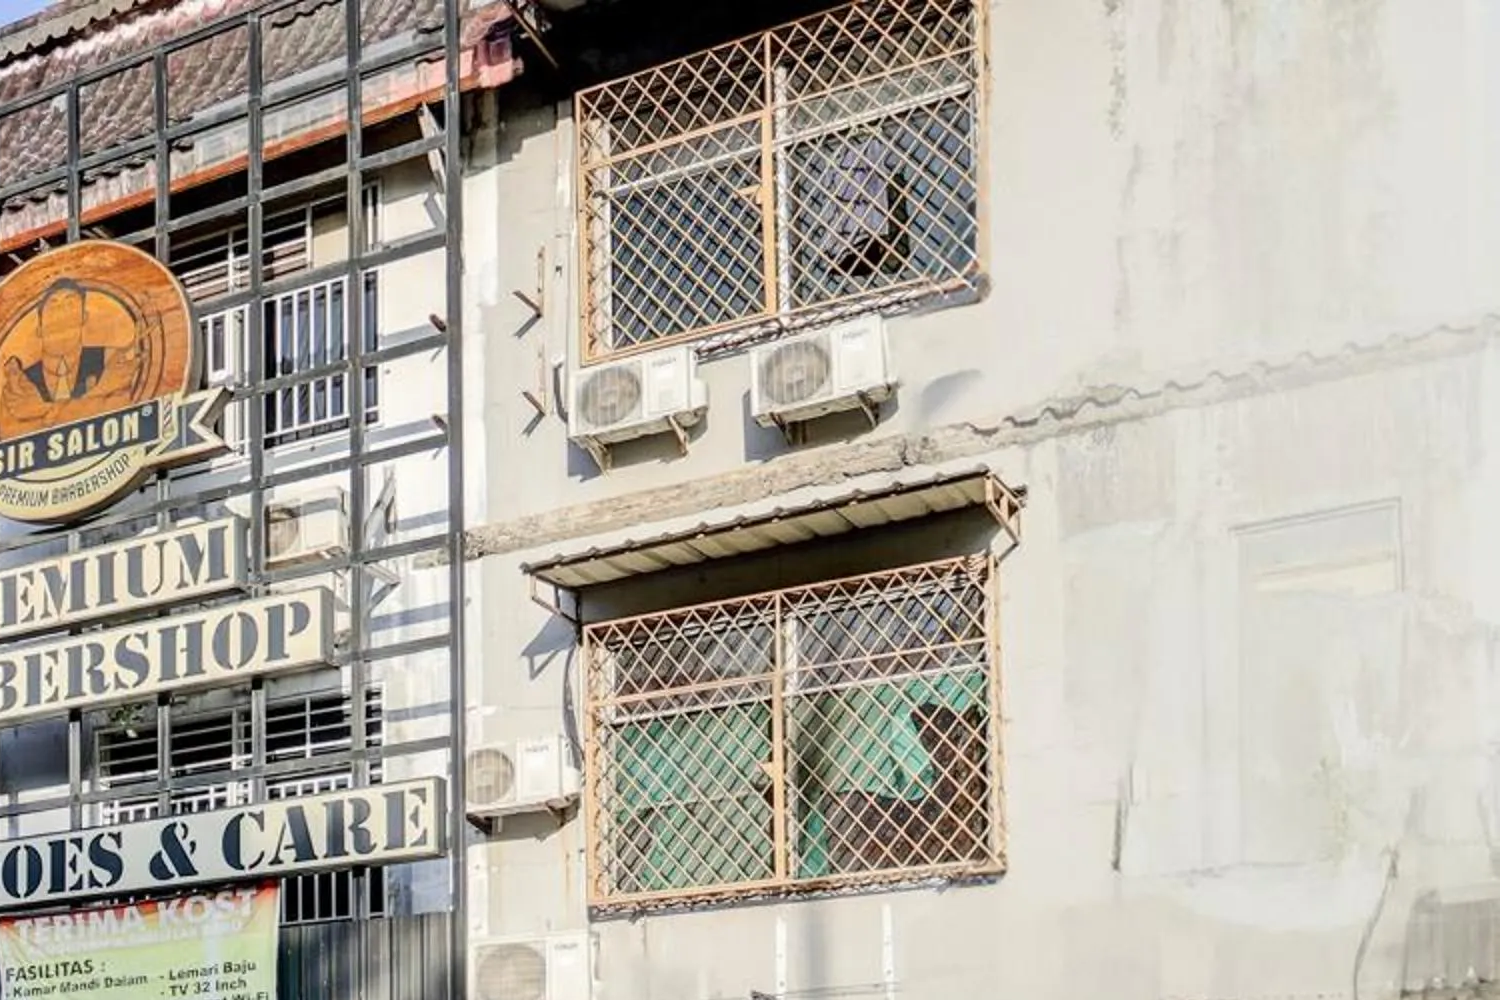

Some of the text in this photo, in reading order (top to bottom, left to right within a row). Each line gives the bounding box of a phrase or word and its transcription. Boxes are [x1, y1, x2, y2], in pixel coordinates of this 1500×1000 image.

[48, 410, 140, 461] SALON
[51, 453, 131, 506] BARBERSHOP
[149, 821, 199, 881] &
[220, 787, 430, 872] CARE
[15, 905, 145, 942] TERIMA
[157, 888, 258, 928] KOST
[5, 959, 94, 983] FASILITAS
[13, 984, 56, 998] Kamar
[59, 979, 101, 994] Mandi
[168, 960, 257, 981] Lemari Baju
[169, 977, 247, 997] TV 32 Inch
